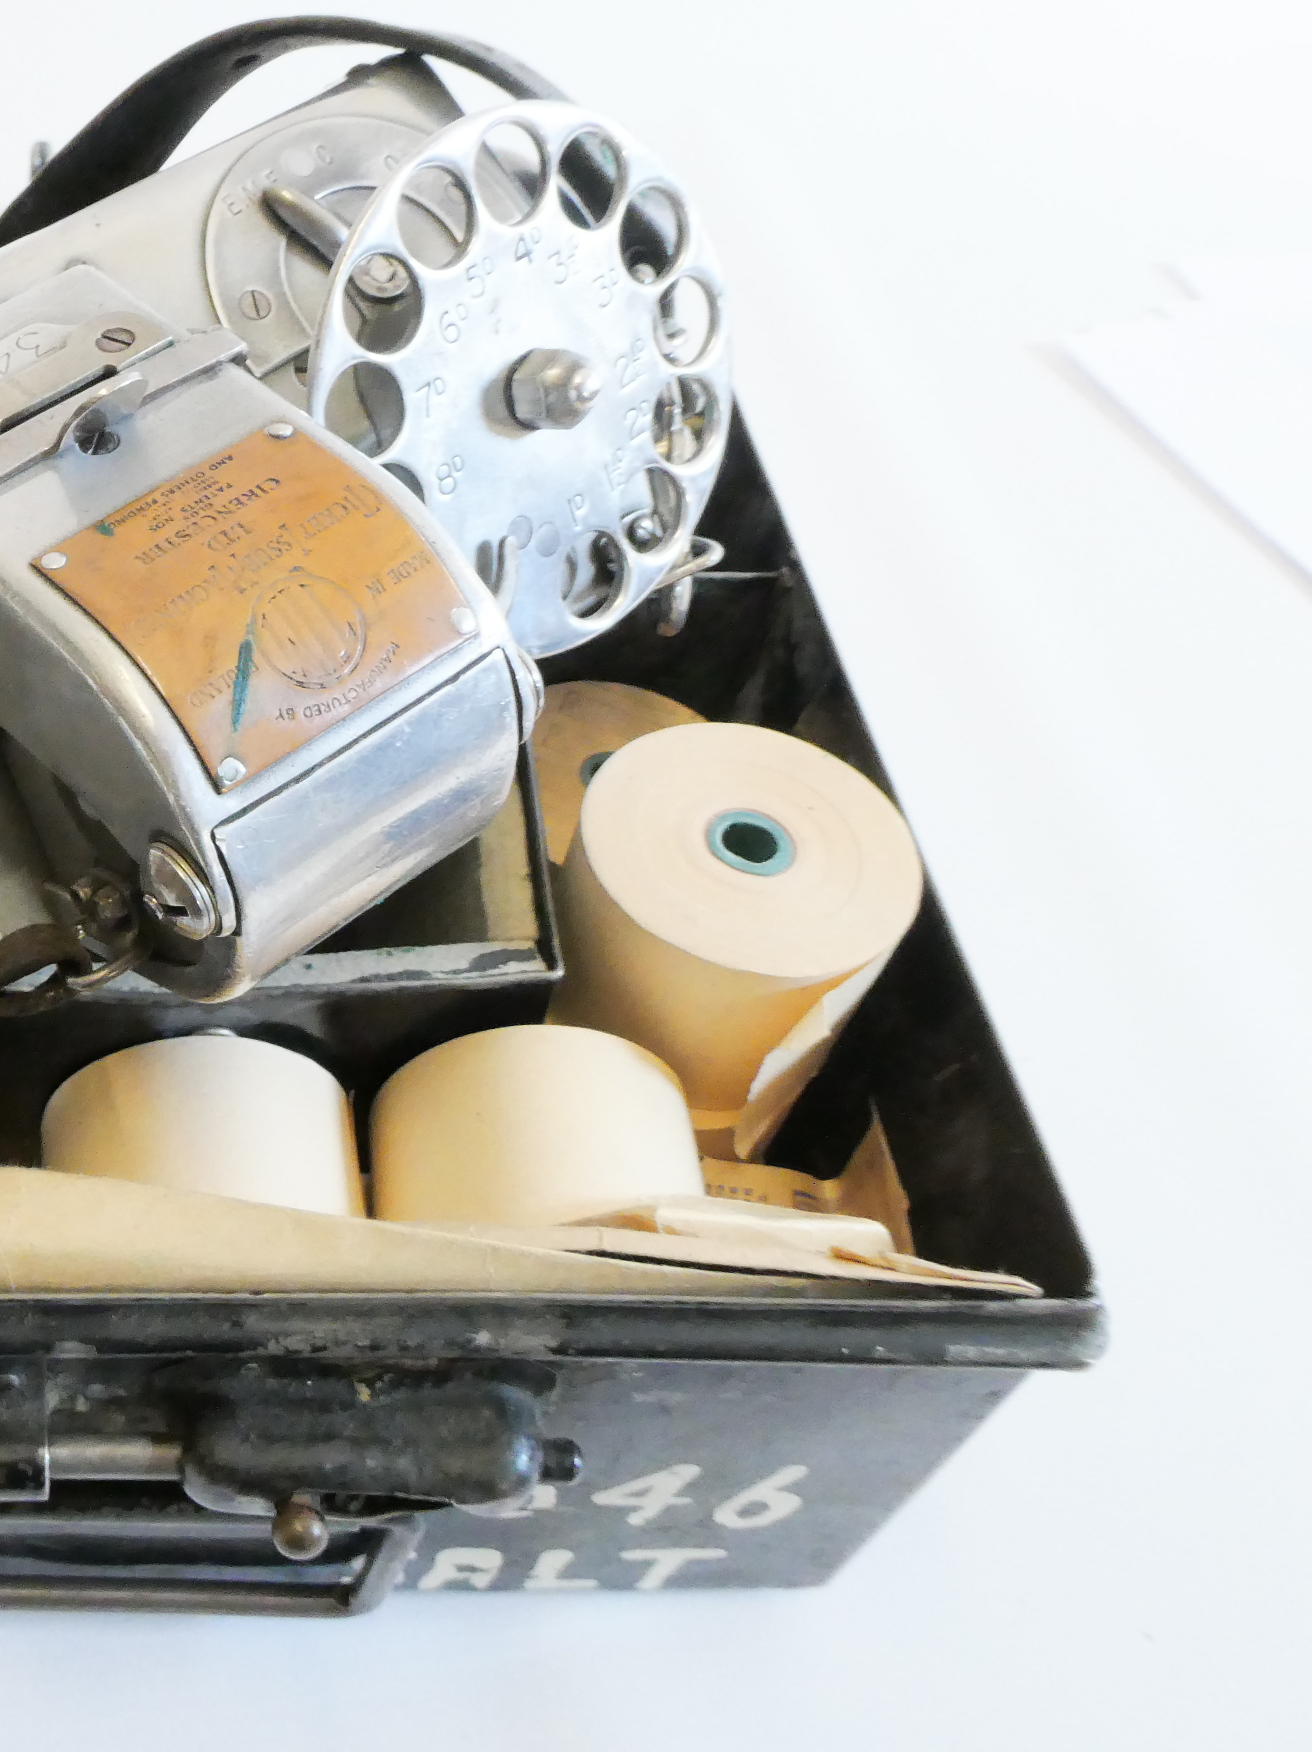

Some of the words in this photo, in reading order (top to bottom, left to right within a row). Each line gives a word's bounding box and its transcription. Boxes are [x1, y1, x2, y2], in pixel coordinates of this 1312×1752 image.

[207, 454, 234, 472] AND
[159, 469, 206, 499] OTHERS
[133, 476, 282, 566] CIRENCESTER
[363, 576, 387, 599] IN
[303, 641, 400, 716] MANUFACTURED
[275, 706, 297, 722] BY
[396, 1546, 728, 1590] ALT
